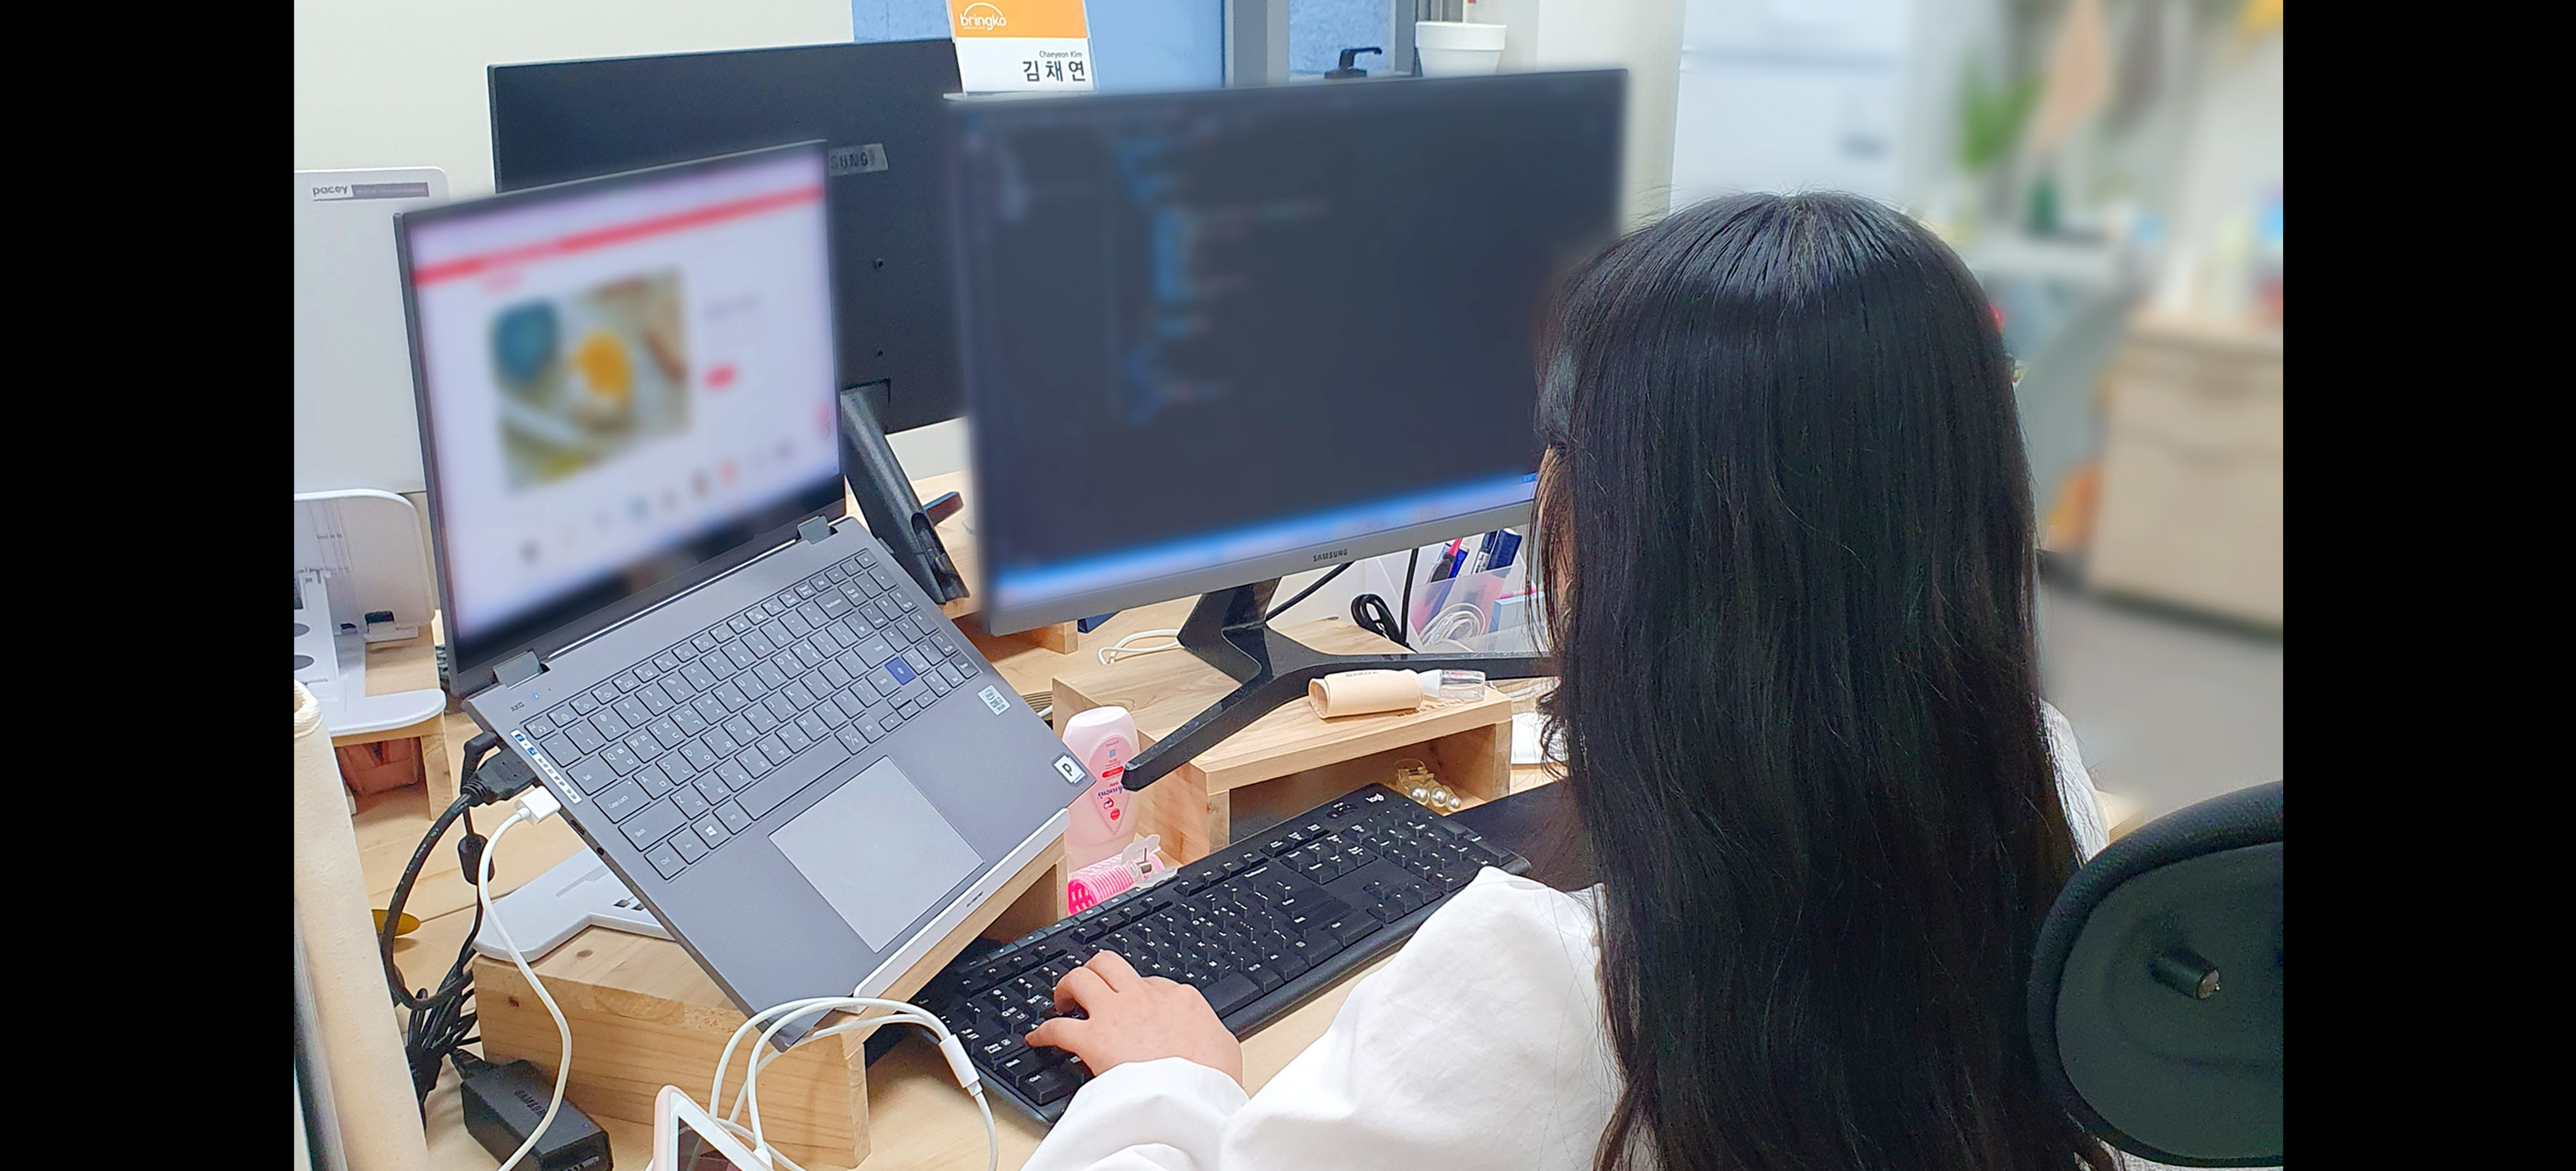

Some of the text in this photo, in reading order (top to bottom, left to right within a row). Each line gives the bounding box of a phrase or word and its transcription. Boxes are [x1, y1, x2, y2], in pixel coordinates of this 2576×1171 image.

[960, 13, 1007, 31] bringko
[1039, 50, 1069, 59] Chaeyeon
[830, 151, 869, 169] SUNG
[312, 185, 348, 196] pacey
[1313, 549, 1348, 562] SAMSUNG
[510, 701, 525, 713] AKG
[1098, 786, 1123, 799] hnson's
[514, 1090, 547, 1118] SAMSUN
